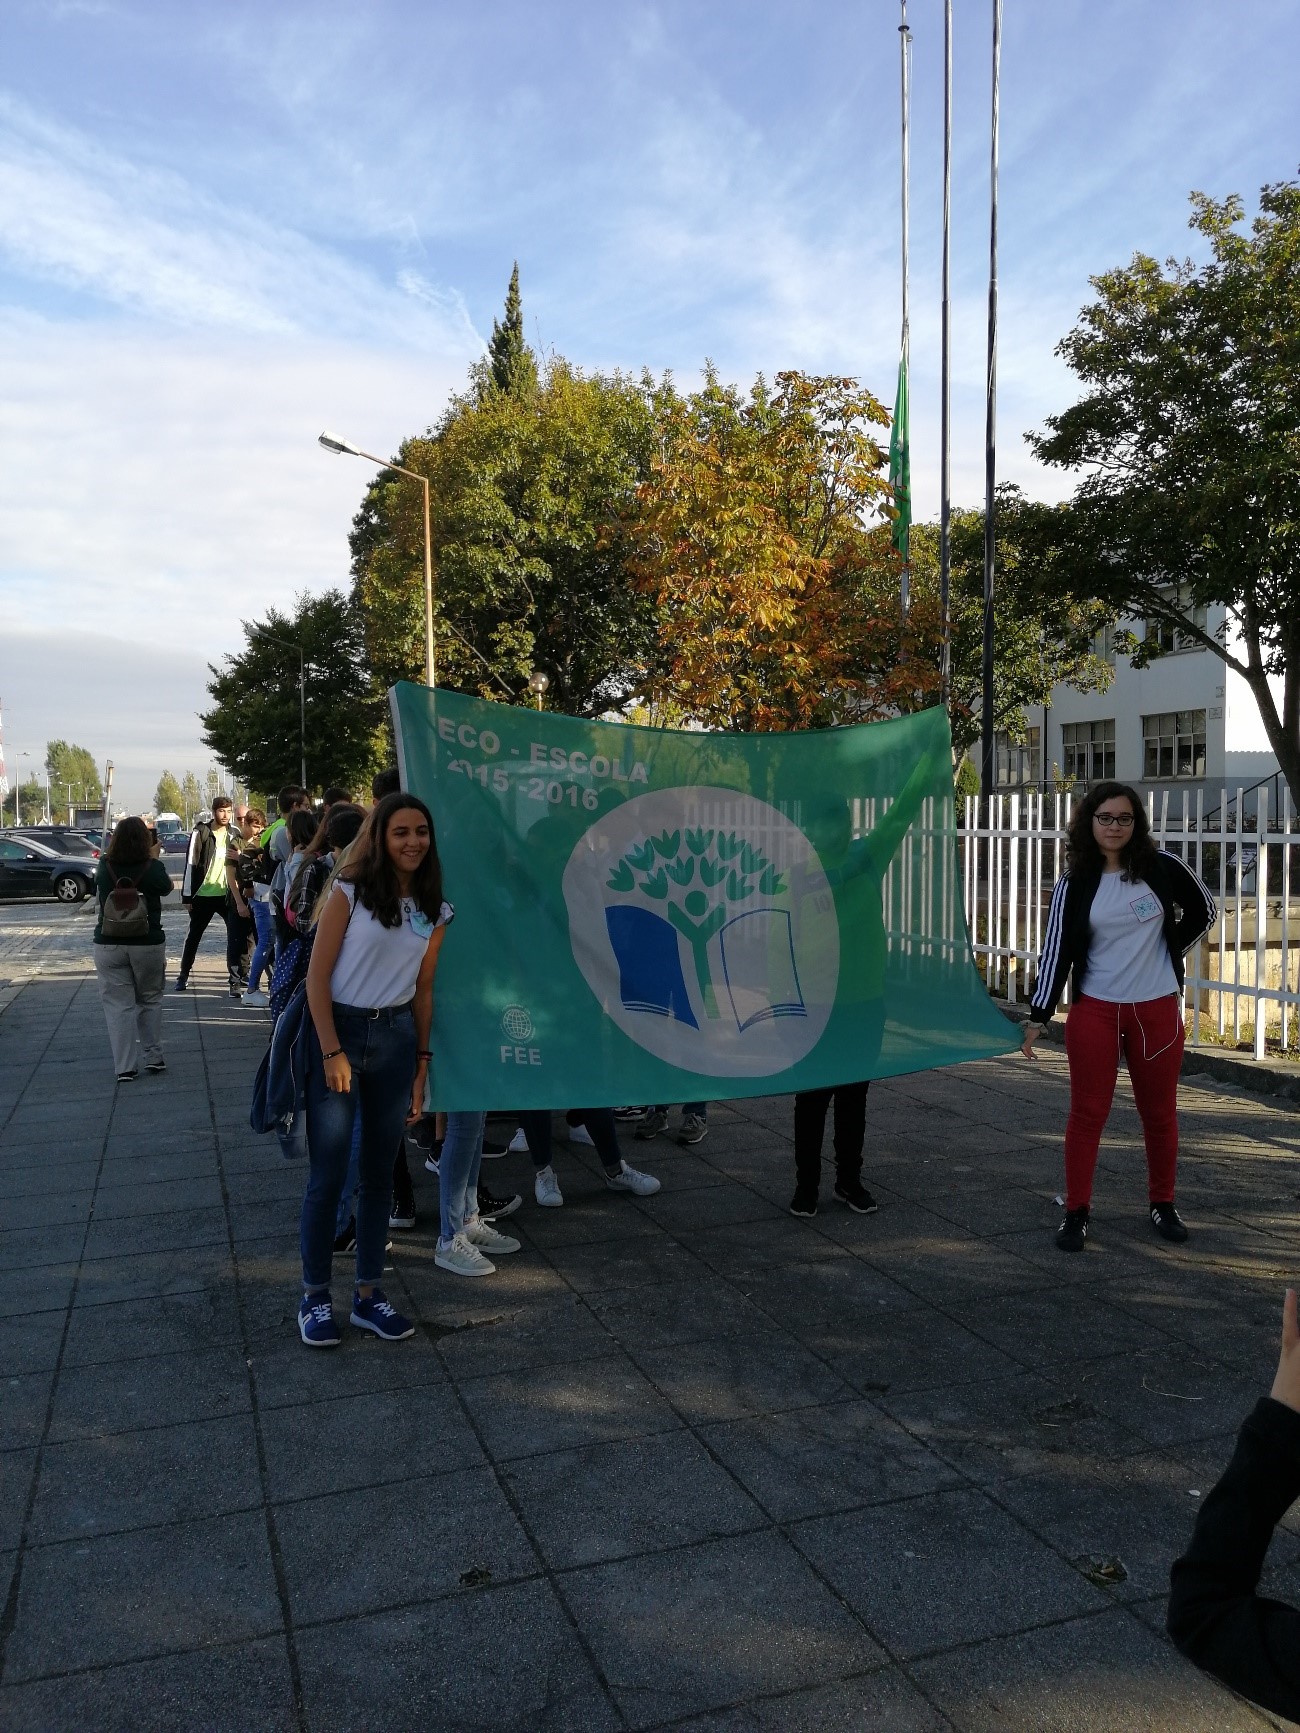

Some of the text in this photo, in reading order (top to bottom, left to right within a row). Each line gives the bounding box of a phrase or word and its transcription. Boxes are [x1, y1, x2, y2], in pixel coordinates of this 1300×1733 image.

[438, 717, 500, 755] ECO
[529, 742, 649, 784] ESCOLA
[500, 1045, 542, 1066] FEE
